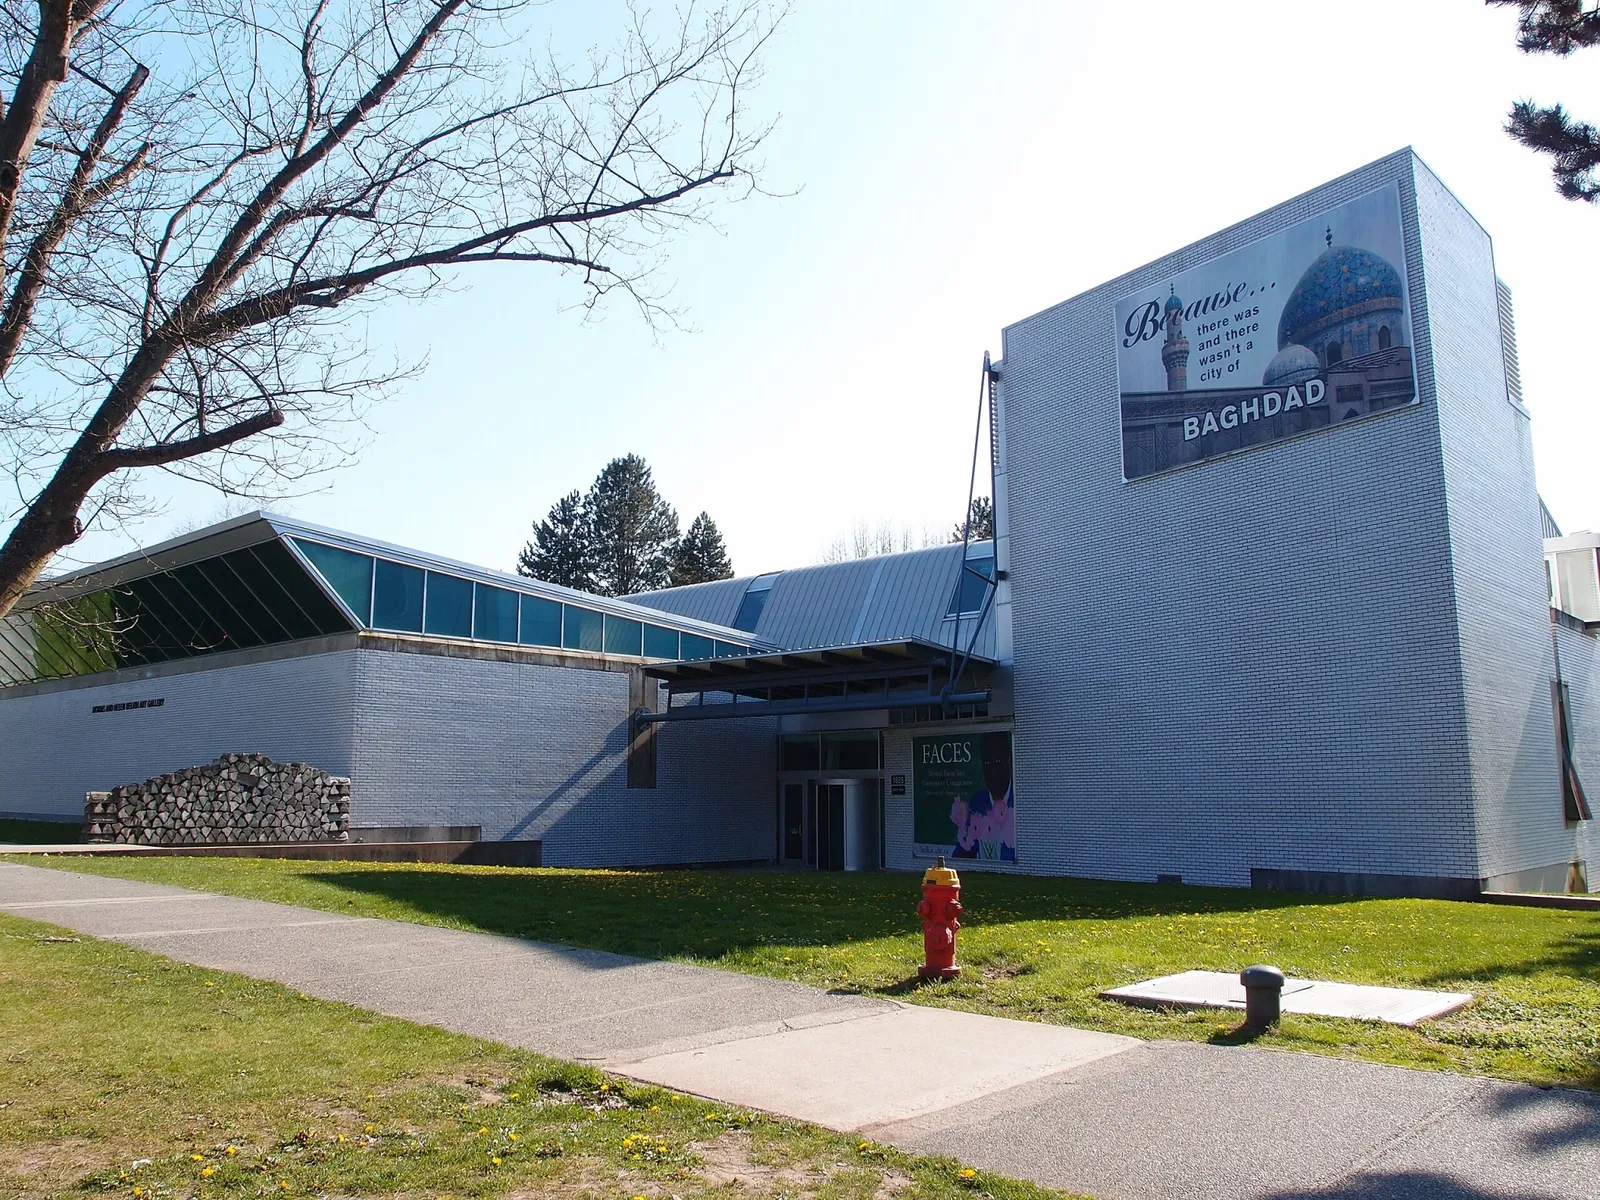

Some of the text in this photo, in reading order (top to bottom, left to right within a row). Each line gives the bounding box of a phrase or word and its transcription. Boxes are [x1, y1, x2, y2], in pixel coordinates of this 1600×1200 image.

[1196, 305, 1260, 337] there was
[1197, 321, 1260, 352] and there
[1198, 340, 1254, 367] wasn't a
[1199, 359, 1241, 383] city of
[1183, 379, 1326, 442] BAGHDAD
[922, 742, 972, 764] FACES
